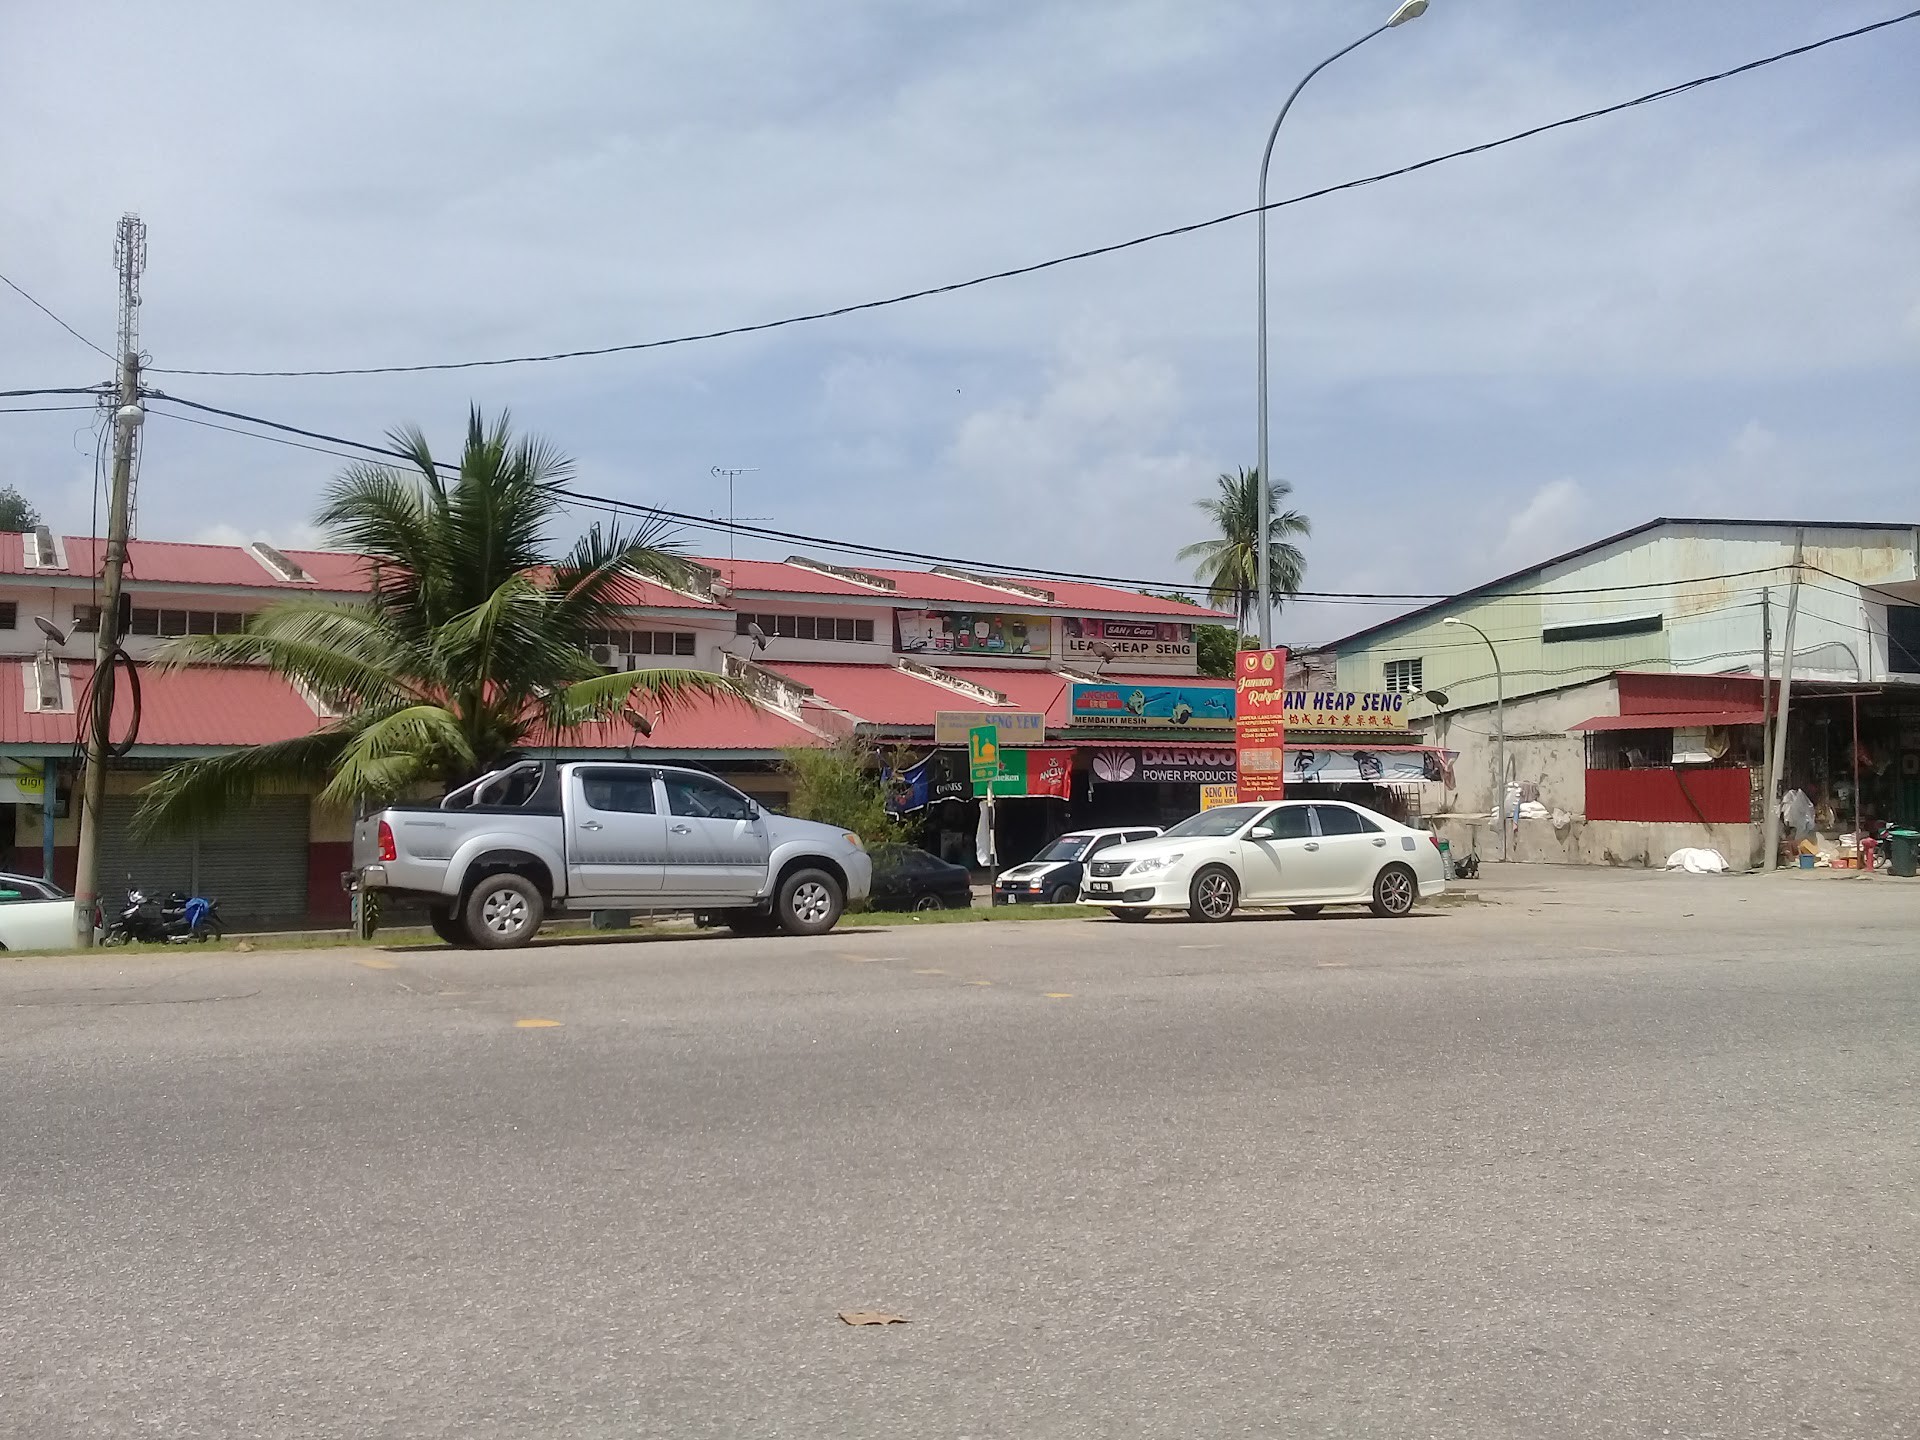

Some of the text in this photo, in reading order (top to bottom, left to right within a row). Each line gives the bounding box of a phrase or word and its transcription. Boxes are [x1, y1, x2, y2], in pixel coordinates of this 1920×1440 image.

[1070, 640, 1191, 655] LEA HEAP SENG
[1081, 691, 1118, 700] ANCHOR
[1248, 688, 1284, 707] Rakyat
[1284, 691, 1403, 712] AN HEAP SENG
[985, 715, 1012, 729] SENG
[1016, 715, 1041, 729] YEW
[1074, 716, 1147, 725] MEMBAIKI MESIN
[1142, 749, 1236, 766] DAEWOO
[1142, 769, 1181, 781] POWER
[1183, 770, 1237, 782] PRODUCTS
[20, 776, 41, 789] digi
[1204, 786, 1222, 798] SENG
